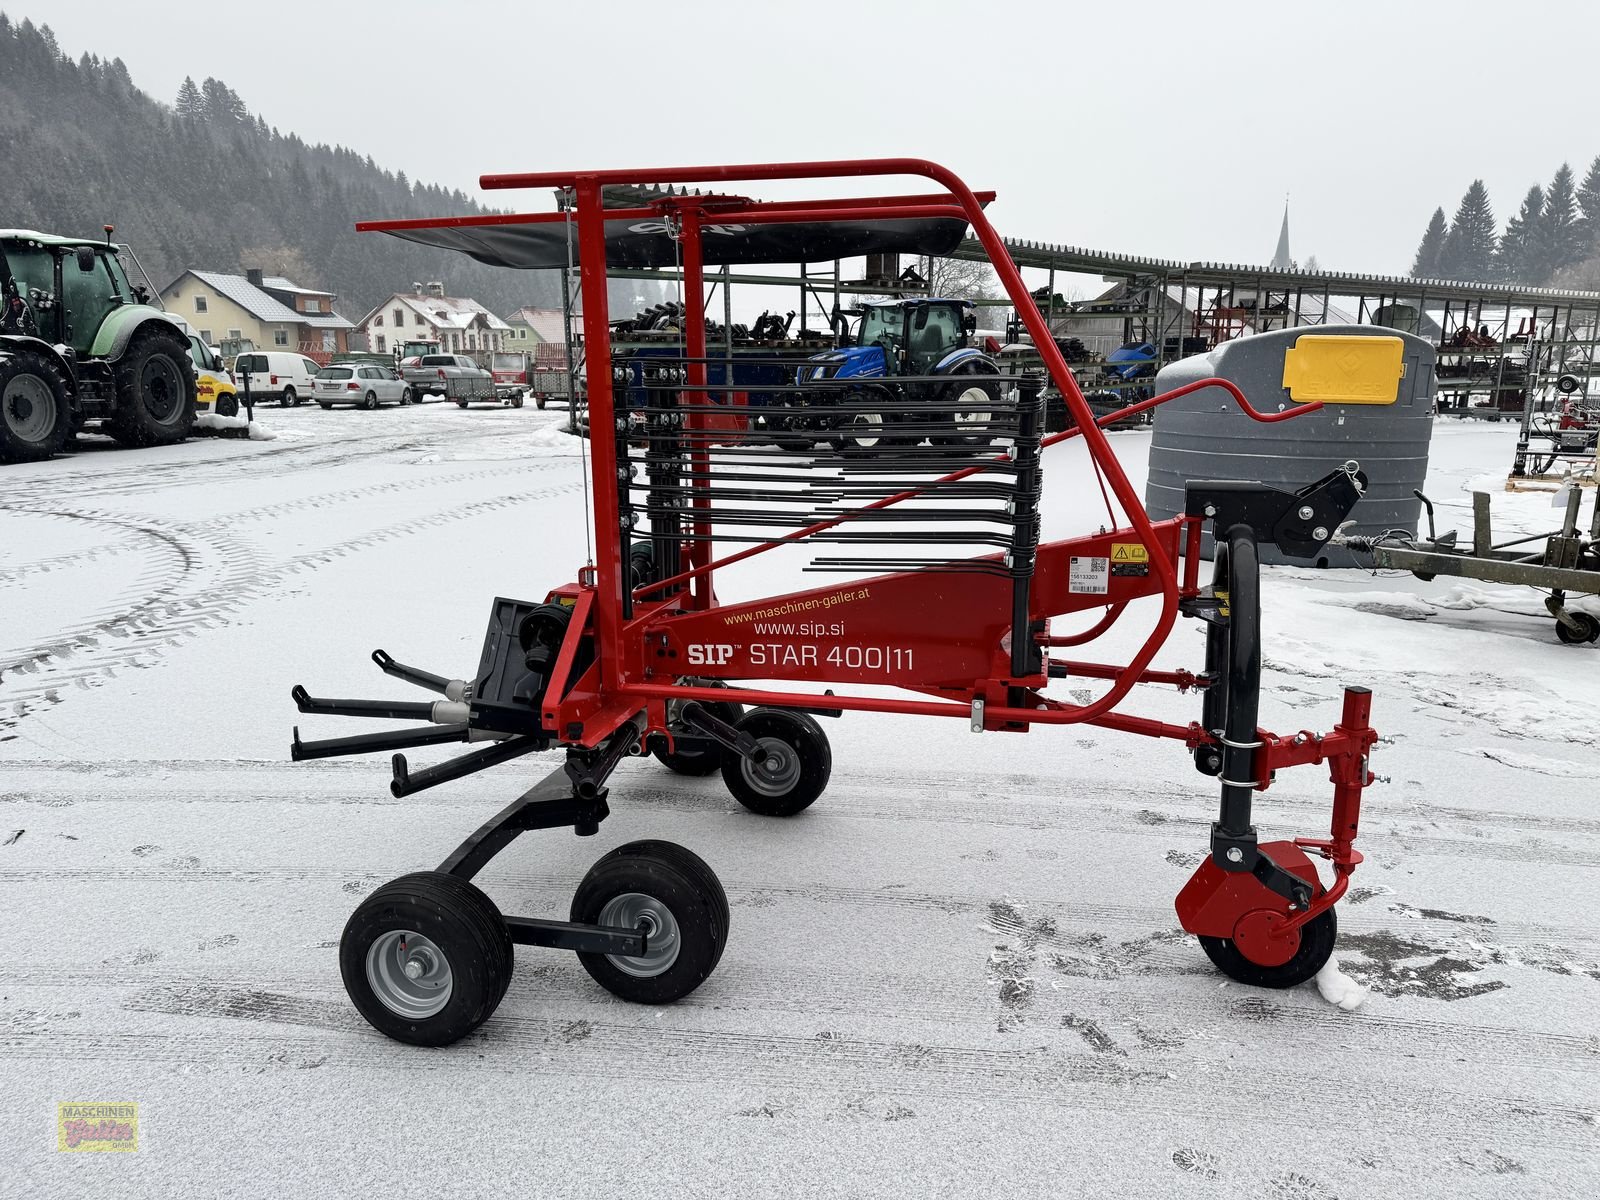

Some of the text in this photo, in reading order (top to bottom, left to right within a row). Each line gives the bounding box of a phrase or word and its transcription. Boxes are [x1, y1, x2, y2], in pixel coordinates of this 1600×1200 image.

[724, 587, 870, 625] www.maschinen-gailer.at
[754, 621, 845, 637] www.sip.si
[750, 644, 818, 666] STAR
